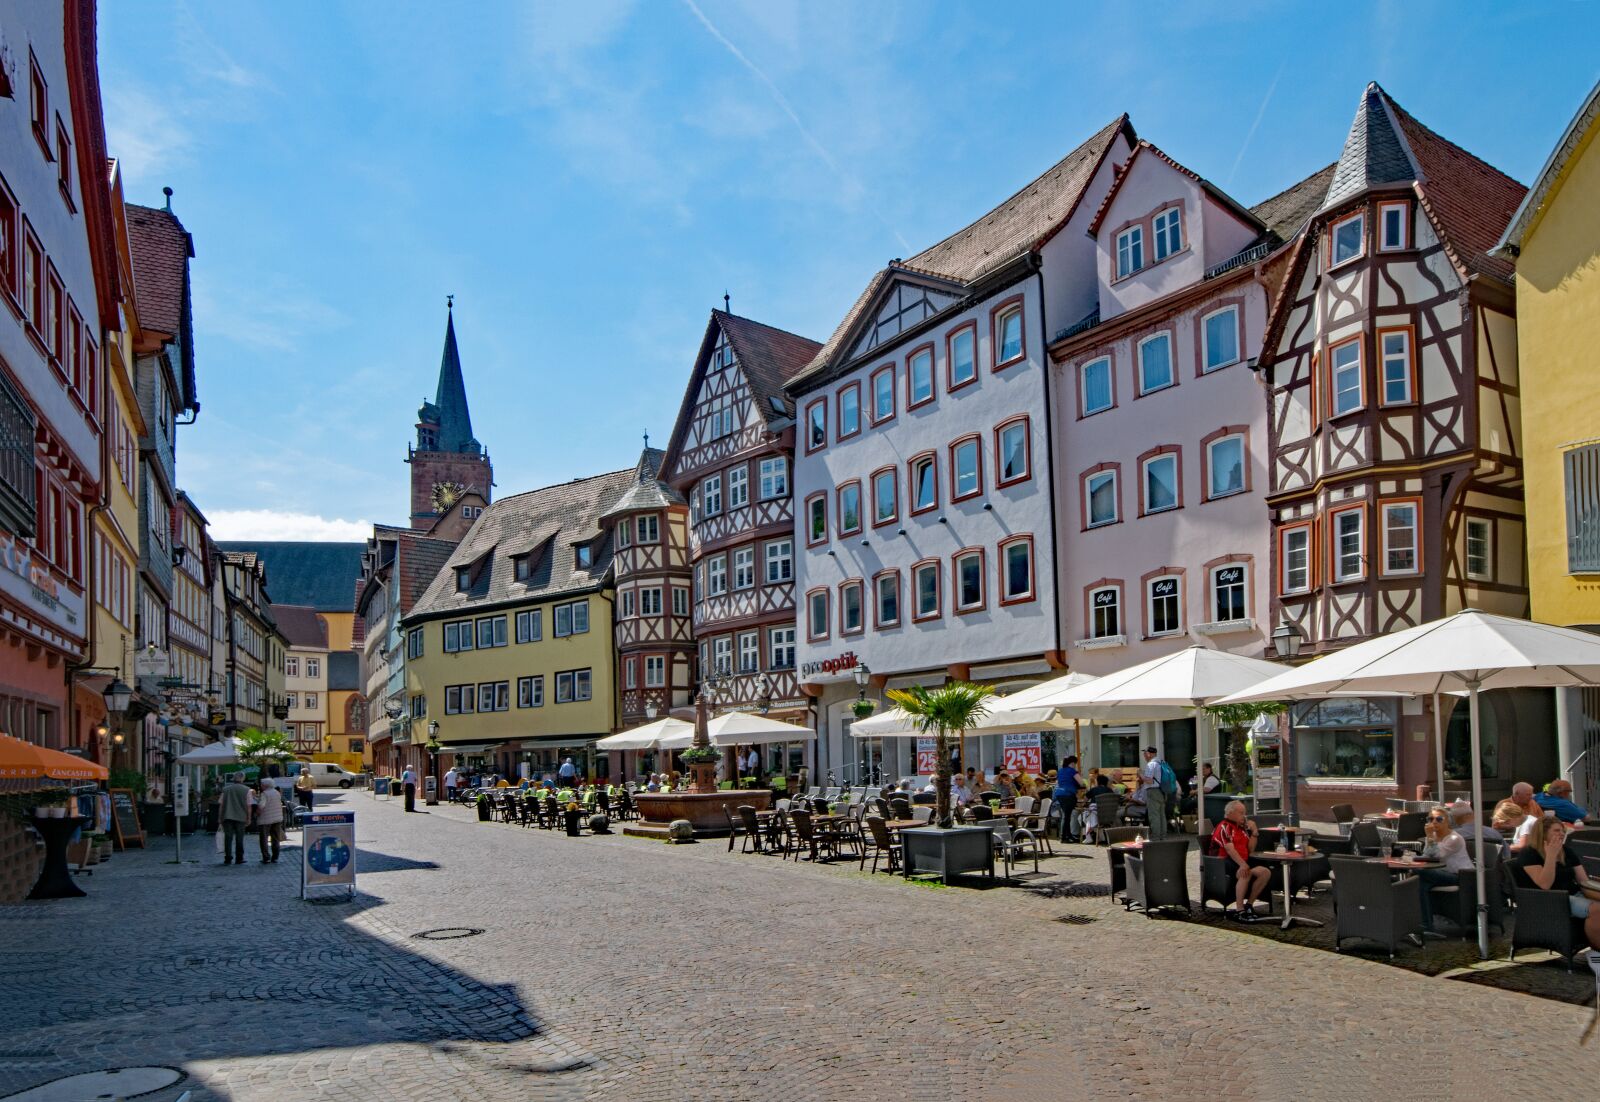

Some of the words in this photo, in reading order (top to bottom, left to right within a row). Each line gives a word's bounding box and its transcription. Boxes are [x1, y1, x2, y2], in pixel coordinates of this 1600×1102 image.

[1220, 570, 1239, 581] Café
[1156, 583, 1173, 592] Café
[1097, 593, 1112, 603] Café
[801, 651, 859, 679] prooptik
